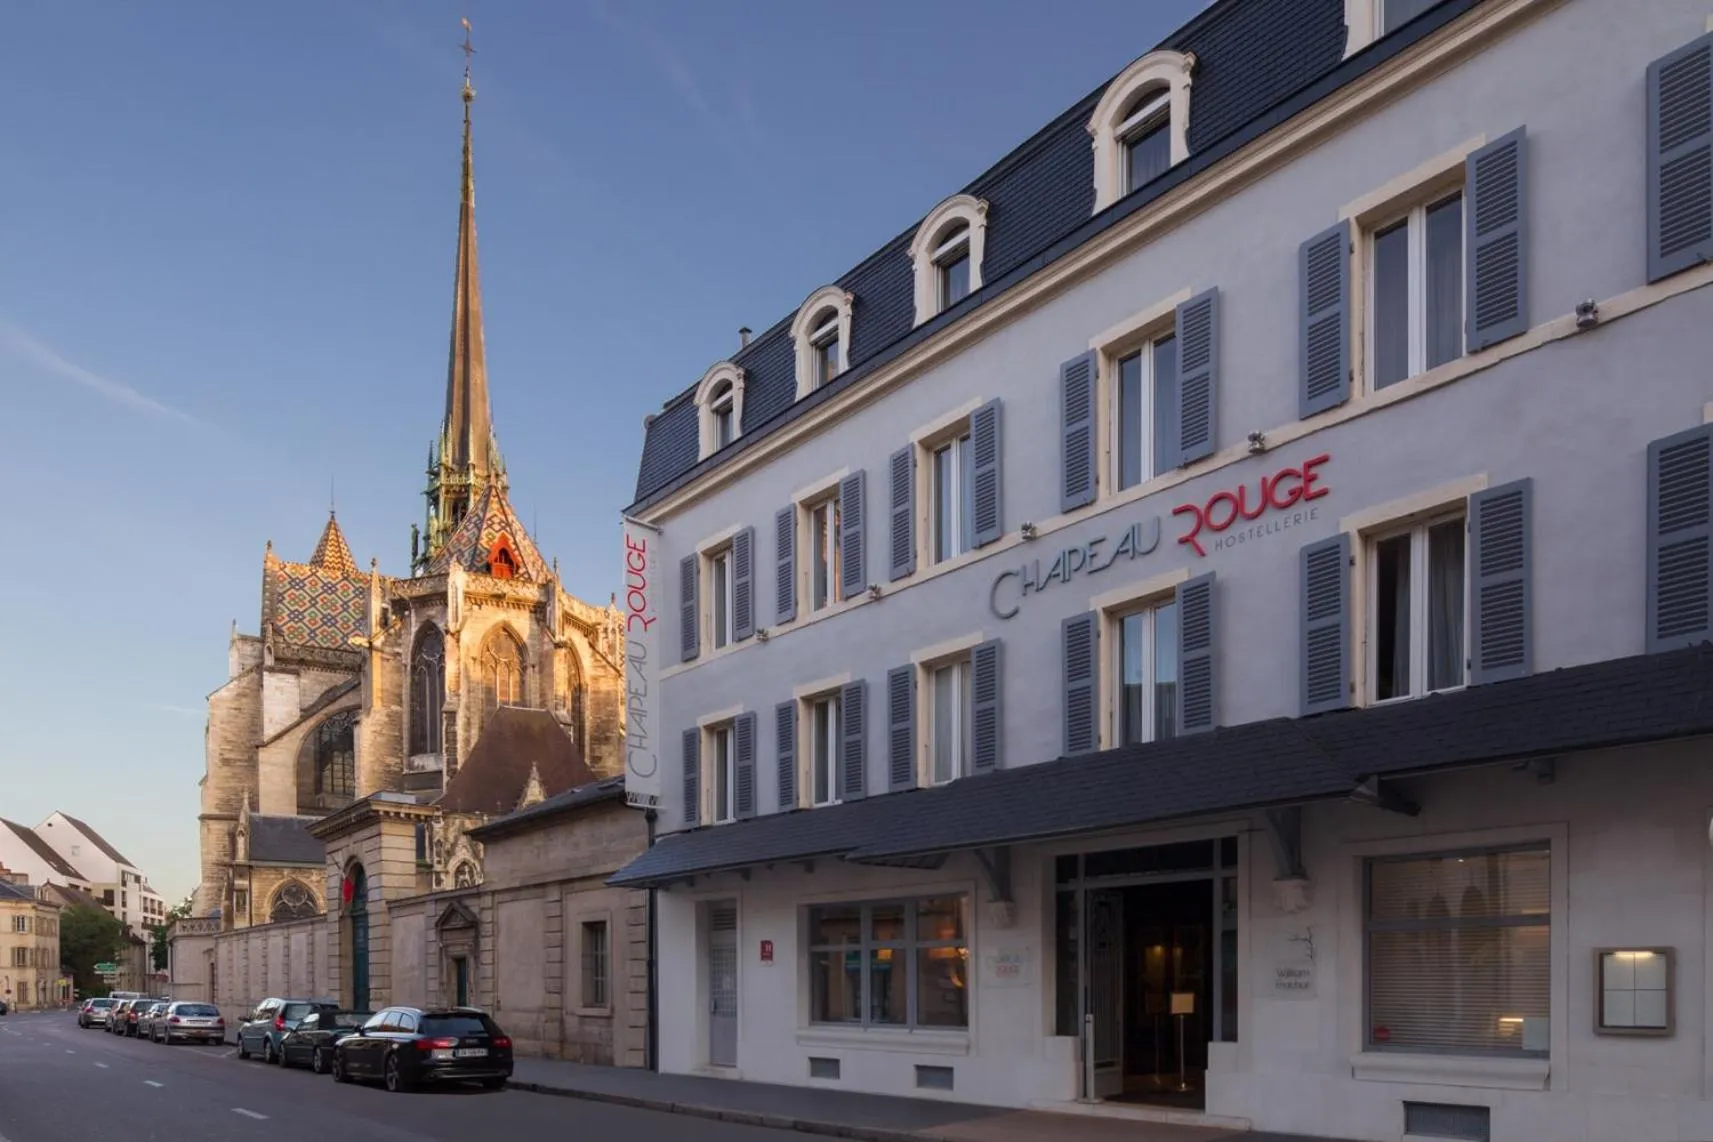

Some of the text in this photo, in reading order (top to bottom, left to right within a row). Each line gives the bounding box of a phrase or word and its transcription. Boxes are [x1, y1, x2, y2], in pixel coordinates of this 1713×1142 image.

[989, 453, 1331, 619] CHAPEAU ROUGE
[1214, 506, 1319, 551] HOSTELLERIE
[626, 533, 658, 779] CHAPEAU ROUGE
